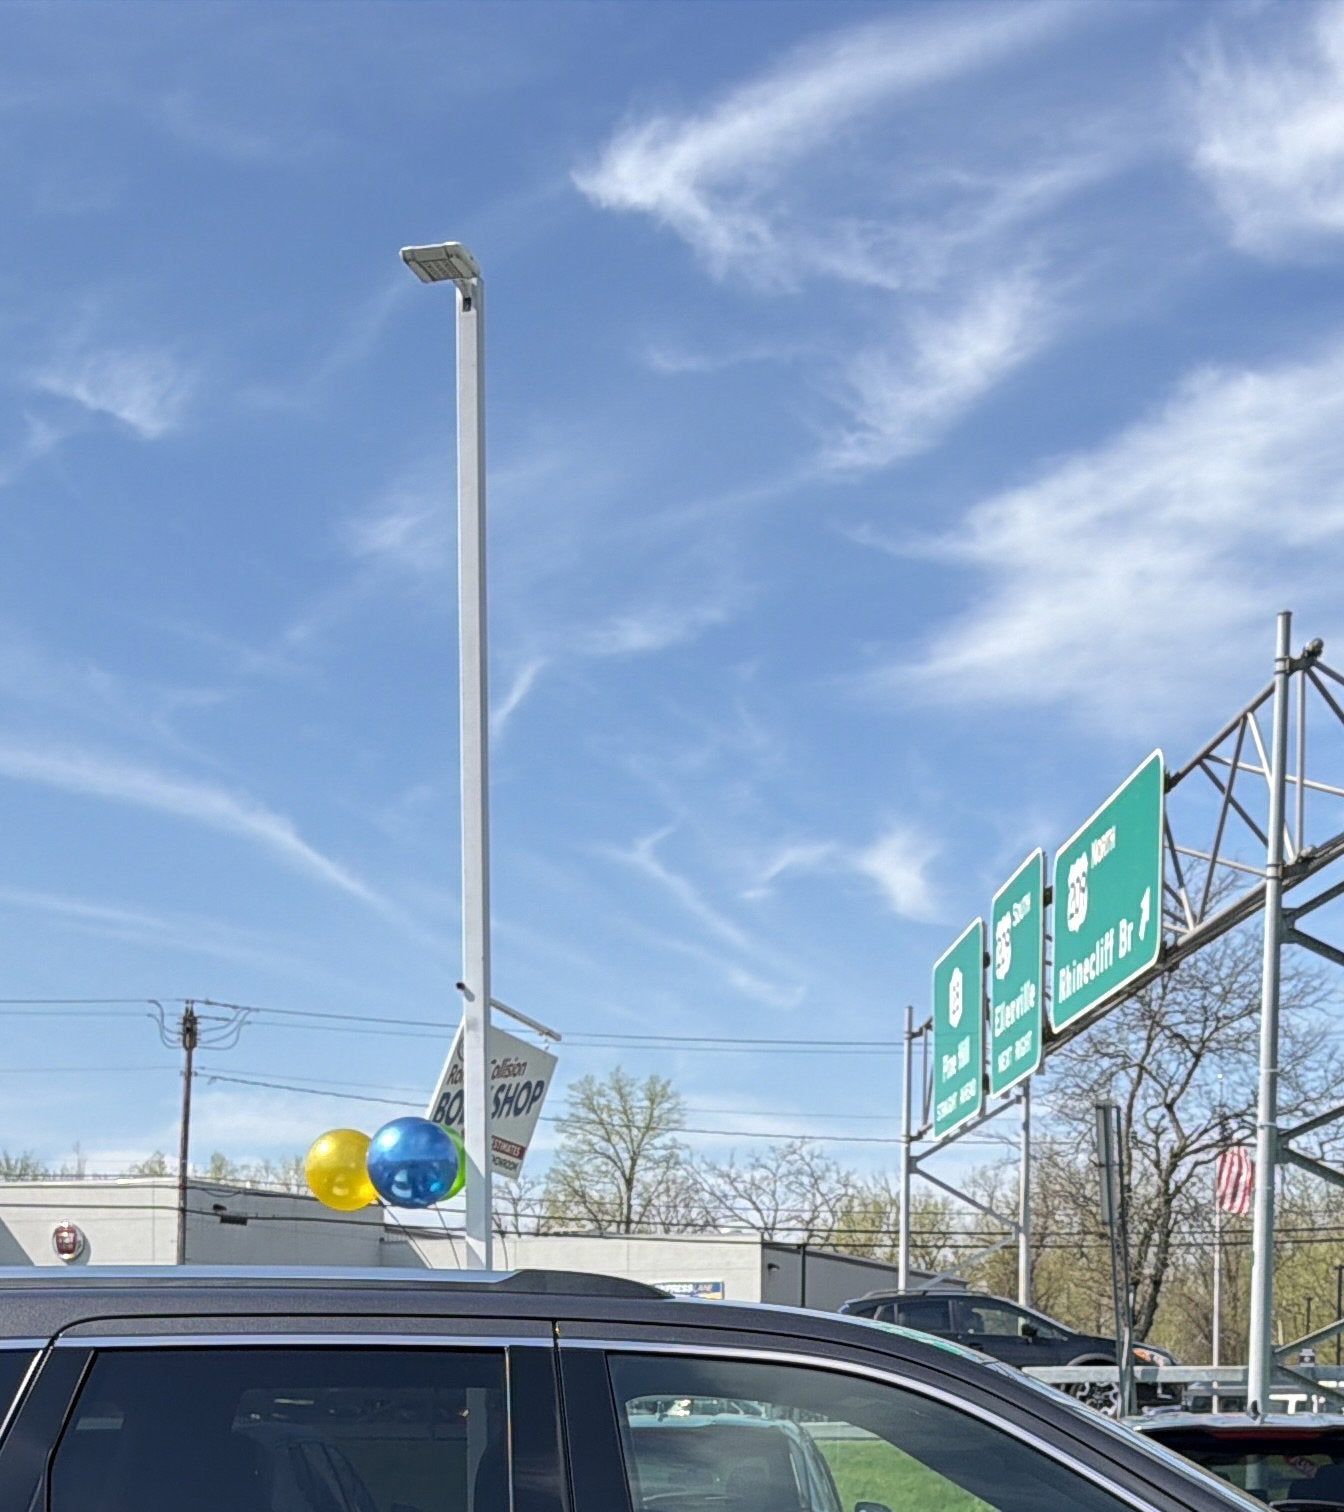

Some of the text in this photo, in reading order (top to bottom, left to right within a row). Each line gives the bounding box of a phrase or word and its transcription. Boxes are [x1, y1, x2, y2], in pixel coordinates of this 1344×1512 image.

[1059, 918, 1133, 1004] Rhinecliff Br
[491, 1056, 528, 1081] ollision
[492, 1080, 545, 1119] SHOP
